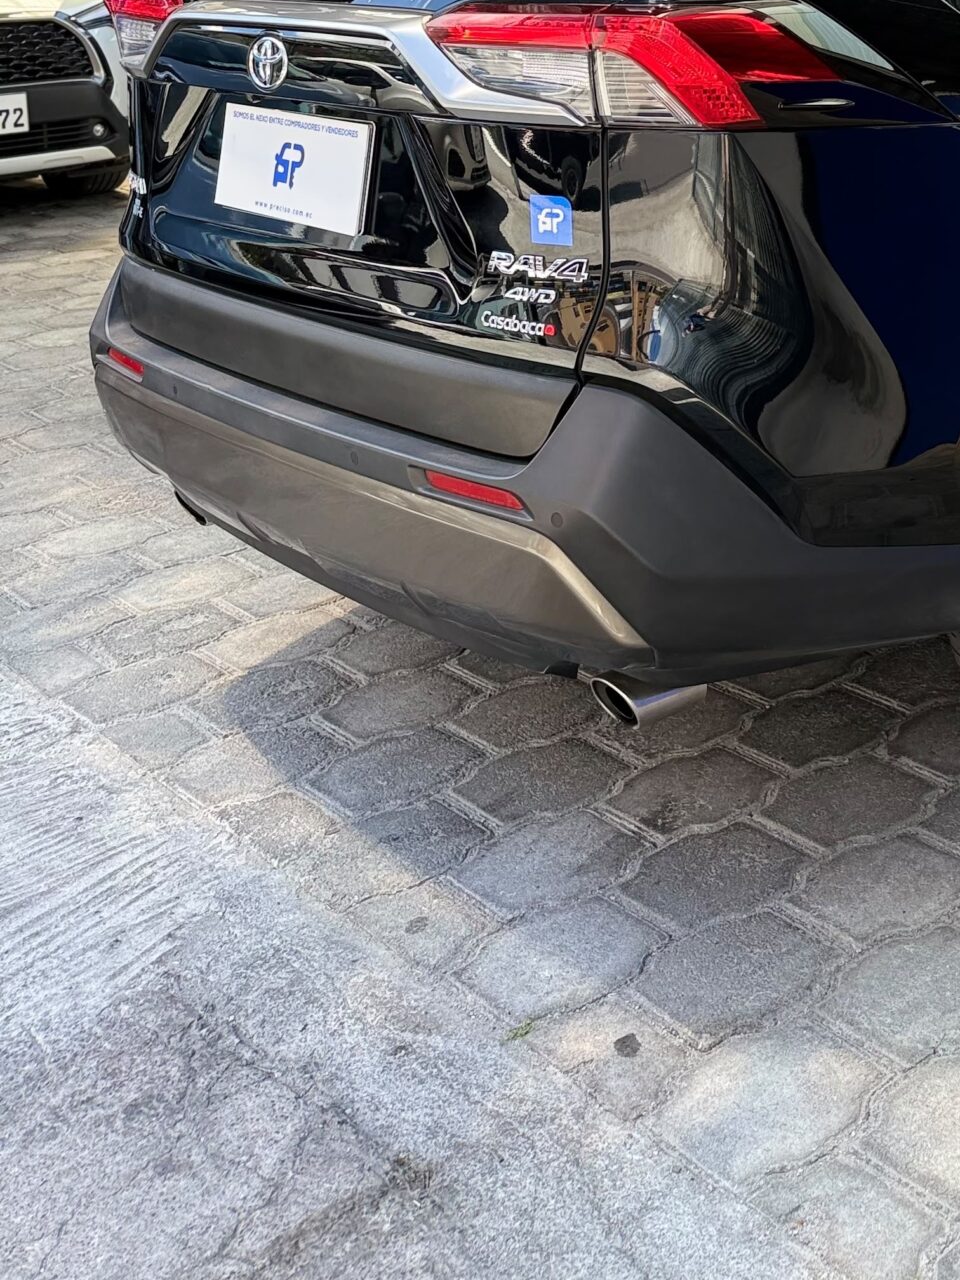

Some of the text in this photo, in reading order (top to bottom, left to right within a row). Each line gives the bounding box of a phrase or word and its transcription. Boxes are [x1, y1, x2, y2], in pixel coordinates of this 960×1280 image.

[233, 110, 249, 120] SOMOS
[256, 114, 268, 122] NEXO
[269, 116, 284, 126] ENTRE
[284, 118, 321, 132] COMPRADORES
[325, 125, 358, 138] VENDEDORES
[254, 200, 313, 219] www.preciso.com.ec
[487, 250, 589, 283] RAV4
[504, 286, 557, 304] 4WD
[481, 310, 545, 336] Casabaca
